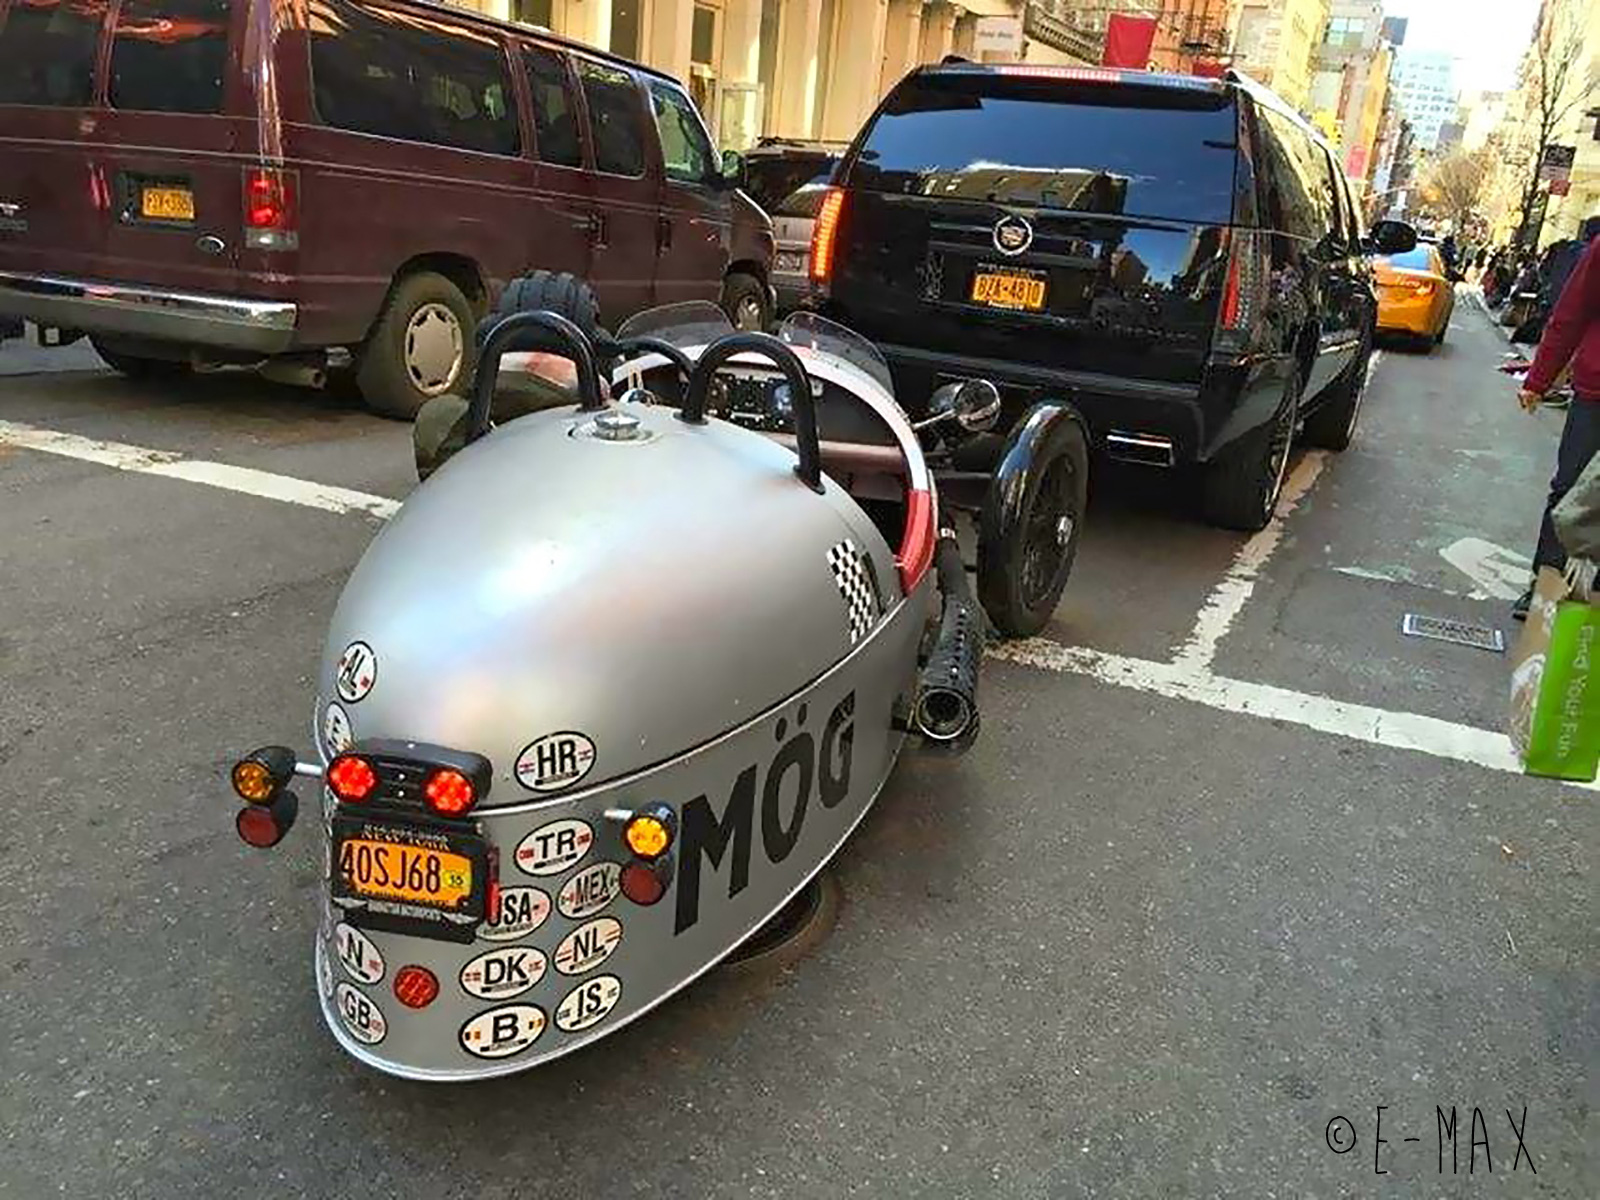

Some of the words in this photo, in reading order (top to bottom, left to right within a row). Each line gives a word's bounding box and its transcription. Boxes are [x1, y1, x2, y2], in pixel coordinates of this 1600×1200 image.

[339, 649, 366, 689] AL
[537, 739, 577, 778] HR
[674, 689, 855, 936] MÖG
[535, 828, 576, 860] TR
[340, 843, 442, 894] 40SJ68
[575, 865, 611, 907] MEX
[347, 932, 363, 968] N
[573, 927, 605, 962] NL
[484, 952, 529, 985] DK
[345, 990, 370, 1029] GB
[577, 982, 602, 1017] IS
[492, 1013, 519, 1043] B
